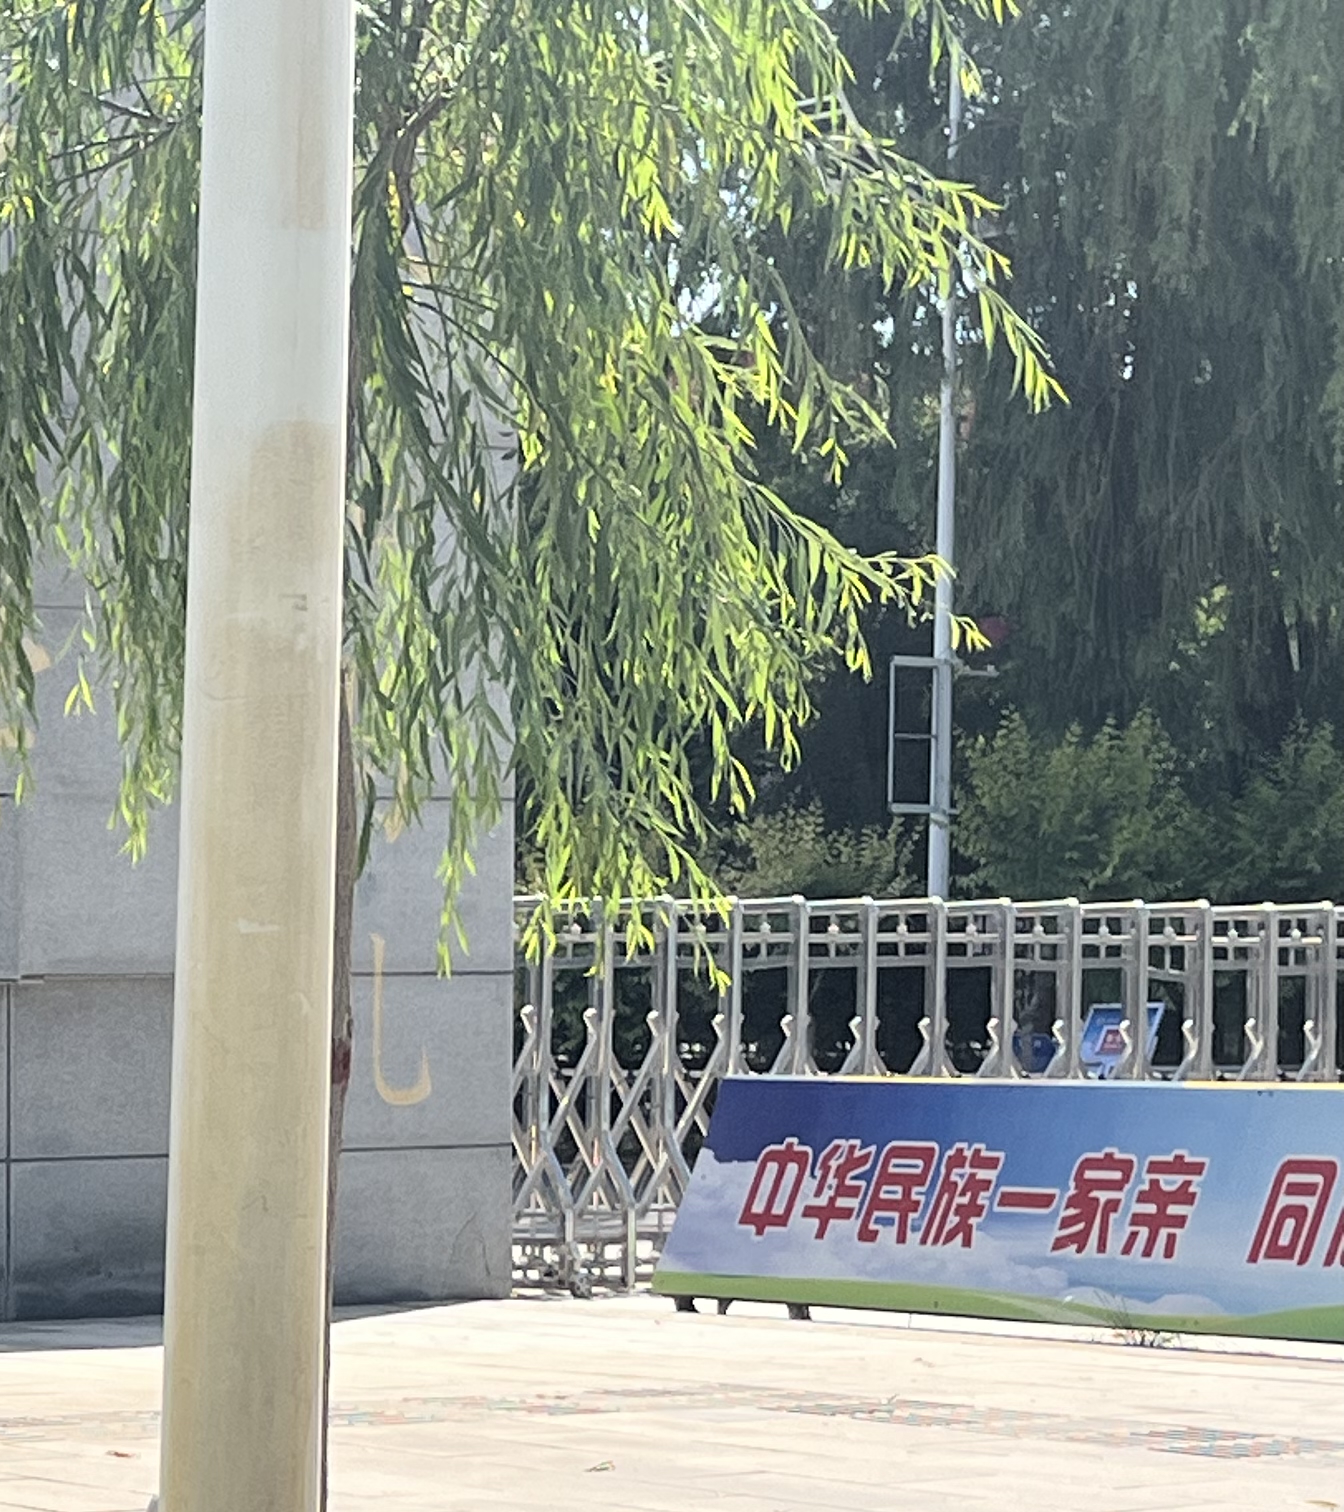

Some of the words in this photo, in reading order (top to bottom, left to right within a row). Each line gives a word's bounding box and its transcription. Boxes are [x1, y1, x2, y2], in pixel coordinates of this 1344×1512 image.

[737, 1140, 1208, 1260] 中华民族一家亲
